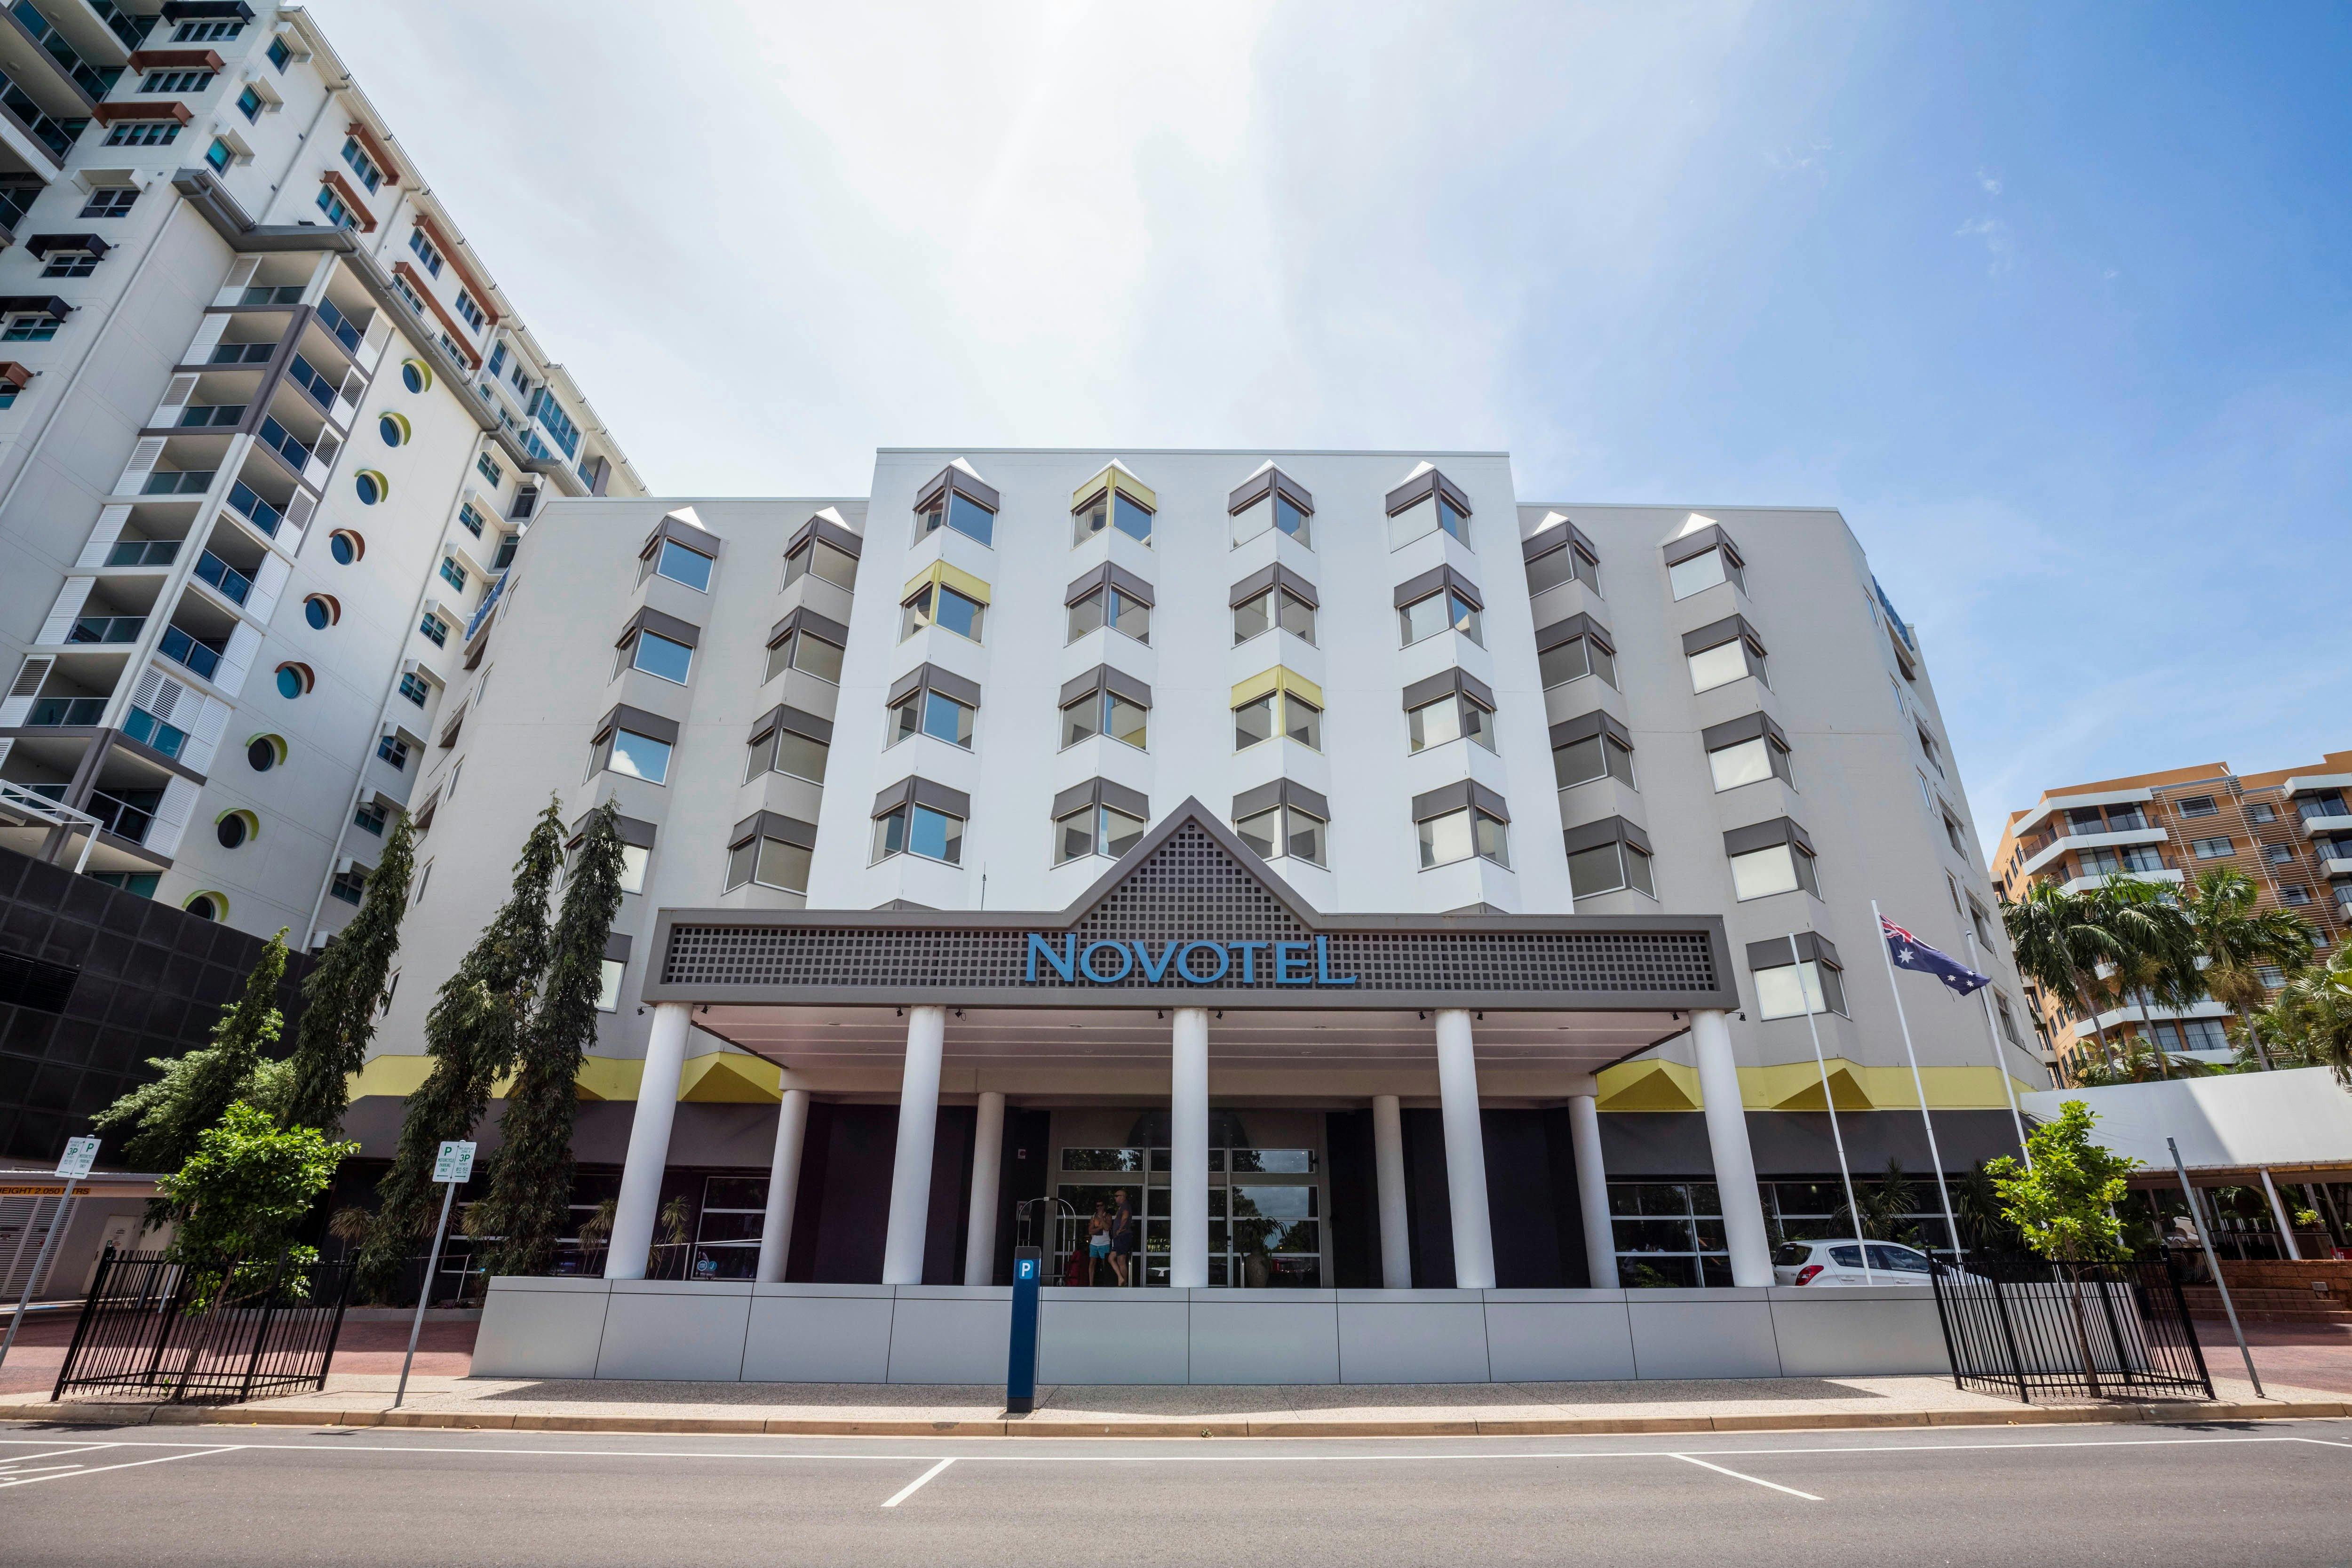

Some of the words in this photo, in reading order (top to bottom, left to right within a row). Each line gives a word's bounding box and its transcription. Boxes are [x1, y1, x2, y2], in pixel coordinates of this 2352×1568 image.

[1025, 933, 1358, 984] NOVOTEL
[86, 1143, 94, 1152] P
[444, 1147, 452, 1156] P
[1022, 1263, 1031, 1277] P
